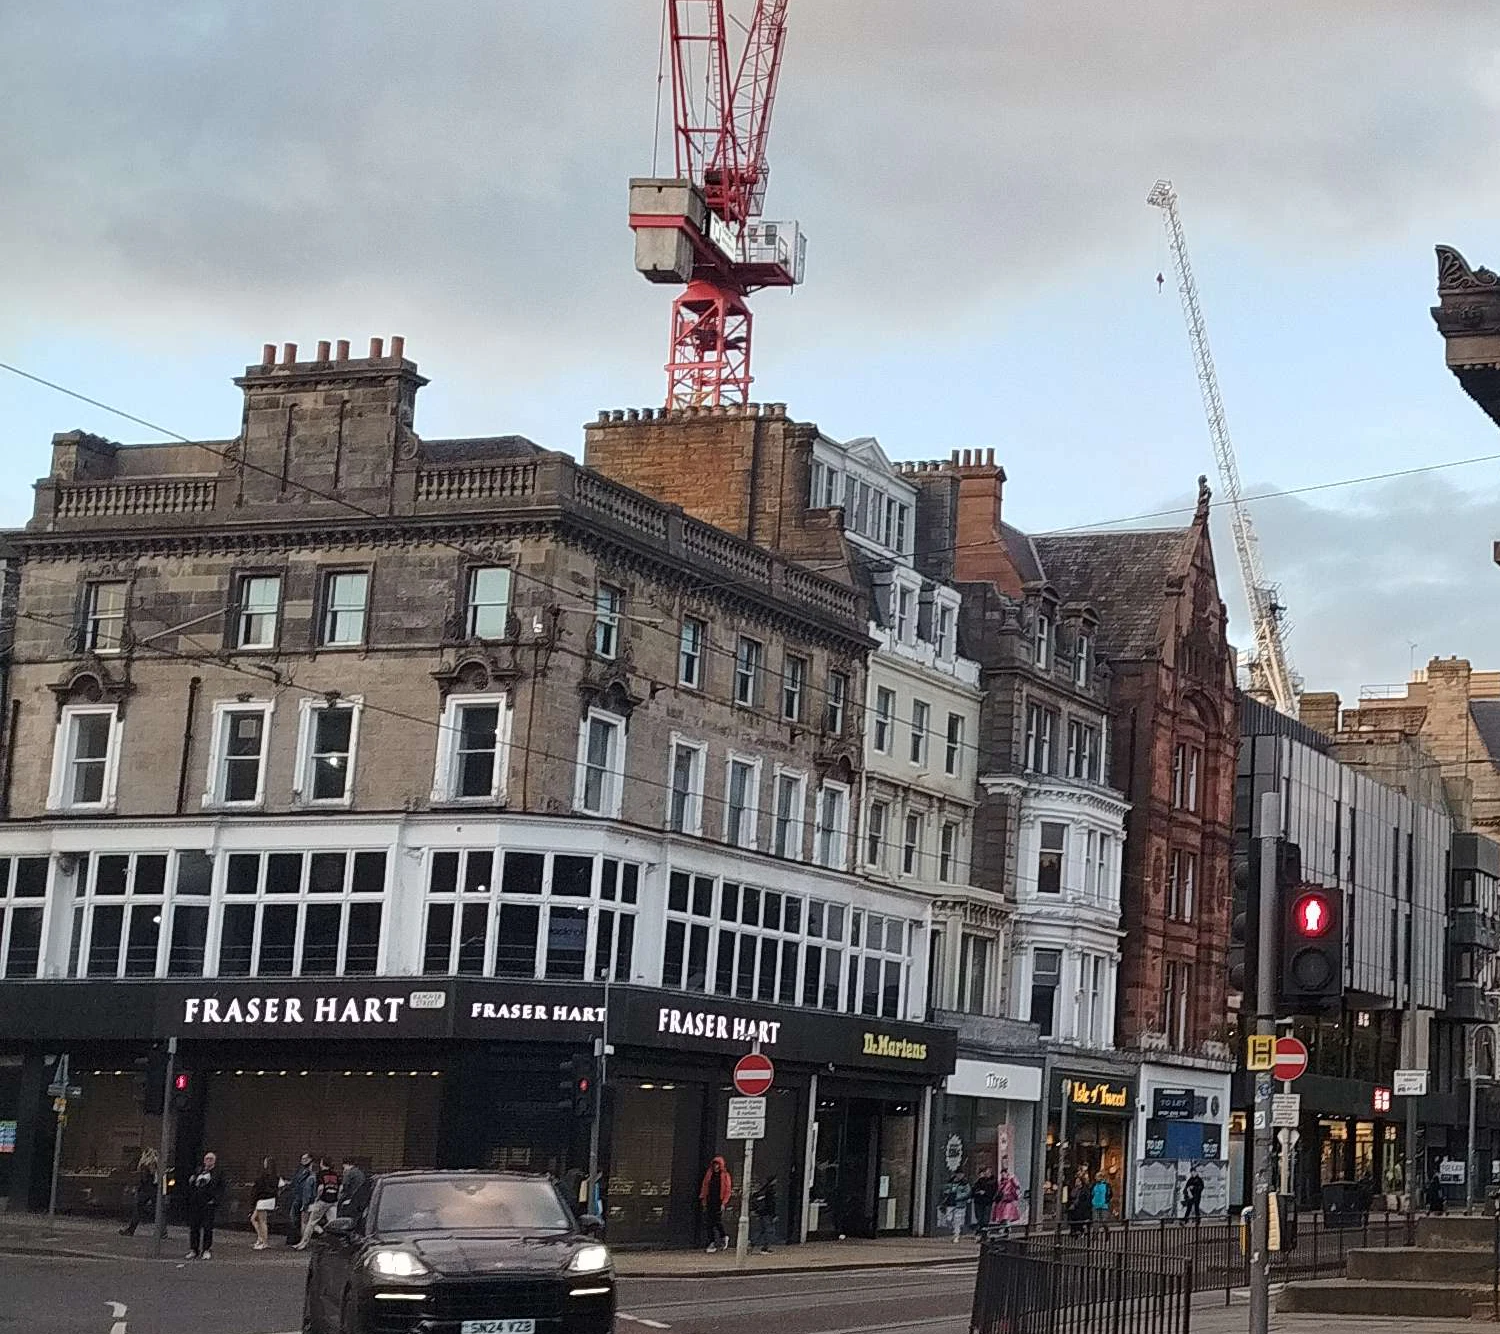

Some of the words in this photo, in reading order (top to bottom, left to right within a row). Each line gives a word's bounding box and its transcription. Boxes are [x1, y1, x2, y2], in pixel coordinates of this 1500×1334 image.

[184, 997, 304, 1023] FRASER
[314, 997, 404, 1023] HART
[471, 1003, 548, 1020] FRASER
[552, 1005, 607, 1023] HART
[658, 1008, 729, 1039] FRASER
[733, 1017, 780, 1044] HART
